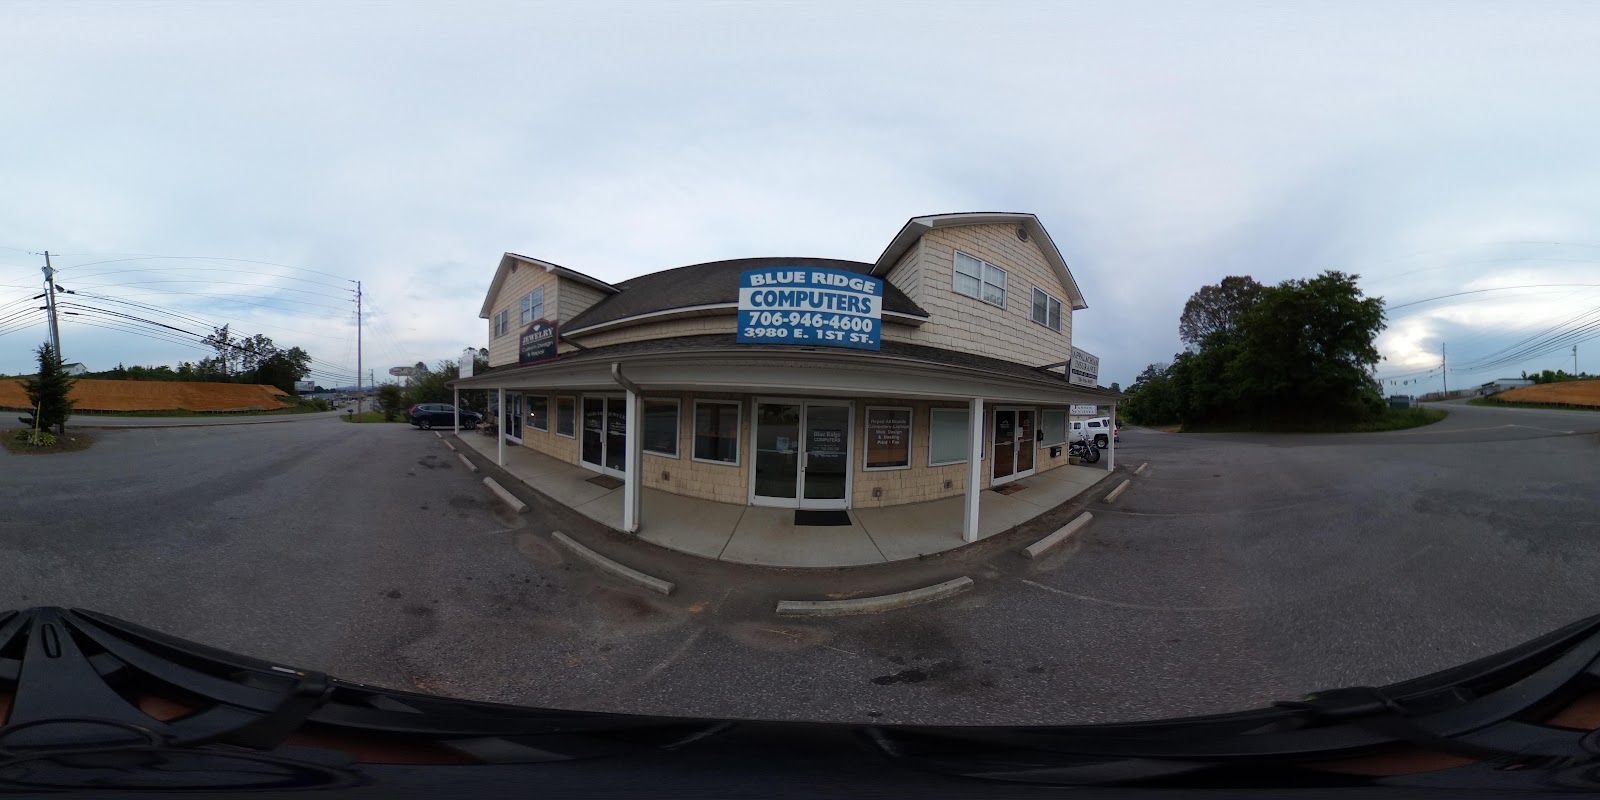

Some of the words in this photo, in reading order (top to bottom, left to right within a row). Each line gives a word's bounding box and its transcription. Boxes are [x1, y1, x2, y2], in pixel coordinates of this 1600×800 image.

[750, 271, 806, 287] BLUE
[812, 272, 876, 294] RIDGE
[750, 290, 872, 315] COMPUTERS
[749, 311, 873, 333] 706-946-4600
[522, 327, 554, 343] JEWELRY
[744, 327, 788, 338] 3980
[793, 328, 809, 339] E.
[816, 329, 845, 341] 1ST
[849, 332, 874, 344] ST.
[537, 341, 553, 349] Design
[1075, 359, 1096, 373] INSURANCE
